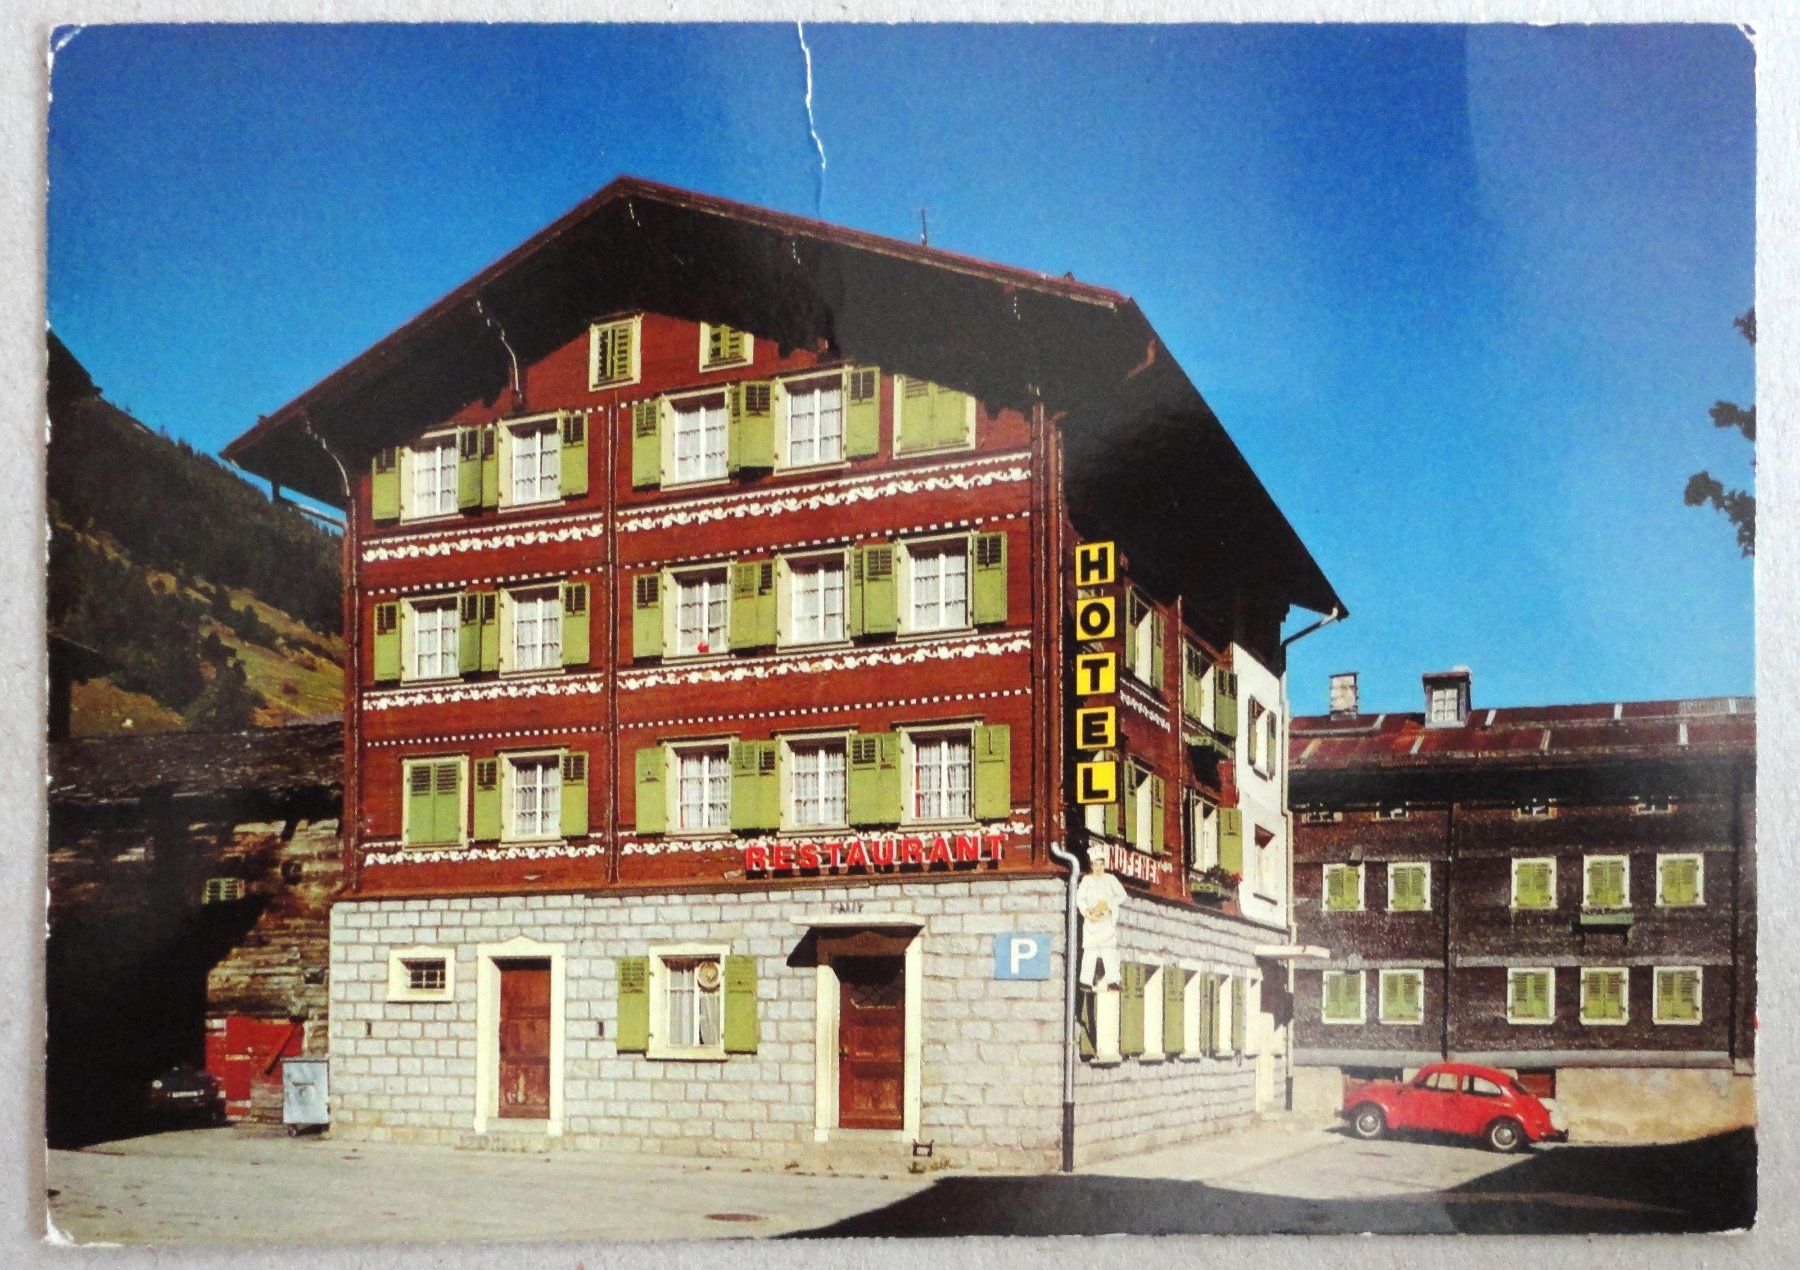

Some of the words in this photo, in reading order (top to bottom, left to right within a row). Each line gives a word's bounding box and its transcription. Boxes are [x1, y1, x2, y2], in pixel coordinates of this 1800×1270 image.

[1079, 545, 1111, 801] HOTEL
[745, 833, 1008, 873] RESTAURANT
[1010, 937, 1039, 974] P
